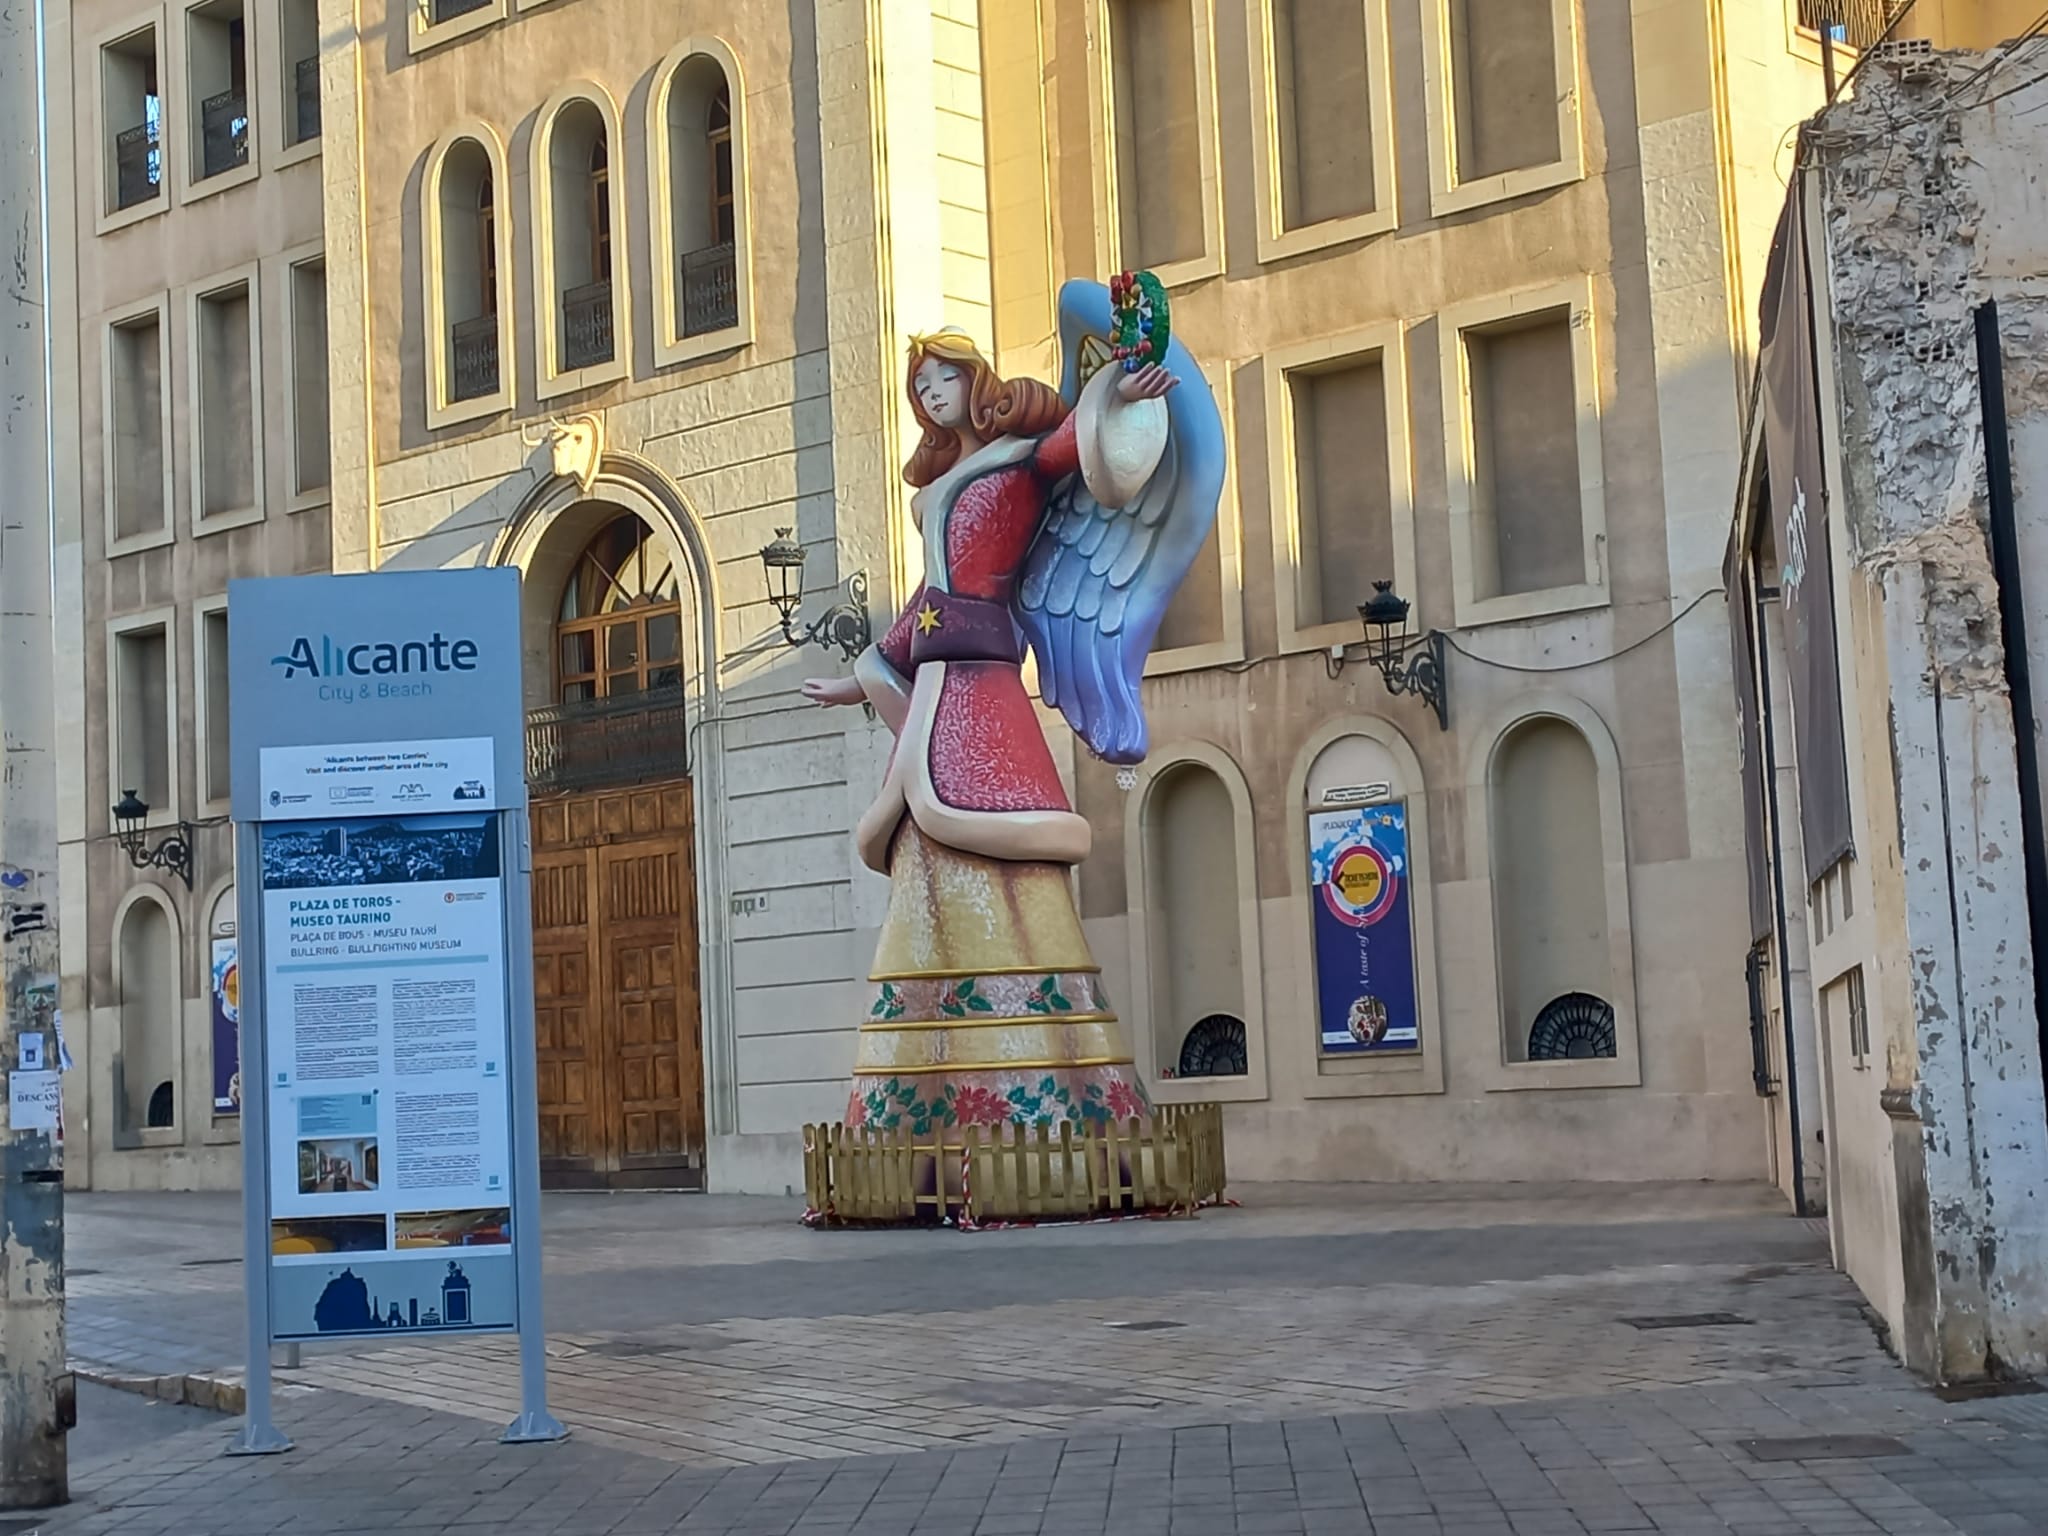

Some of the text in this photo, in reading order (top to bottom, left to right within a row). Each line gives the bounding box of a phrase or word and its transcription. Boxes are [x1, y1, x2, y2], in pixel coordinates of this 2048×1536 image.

[271, 632, 478, 679] Alicante
[318, 680, 433, 704] City & Beach
[290, 900, 330, 912] PLAZA
[332, 898, 350, 910] DE
[352, 896, 393, 909] TOROS
[290, 912, 391, 928] MUSEO TAURINO
[291, 932, 322, 943] PLAÇA
[324, 932, 336, 941] DE
[338, 930, 364, 940] BOUS
[374, 927, 408, 938] MUSEU
[410, 925, 436, 936] TAURÍ
[1356, 931, 1370, 948] of
[291, 946, 339, 958] BULLRING
[348, 942, 416, 954] BULLFIGHTING
[419, 939, 462, 950] MUSEUM
[1360, 948, 1368, 976] taste
